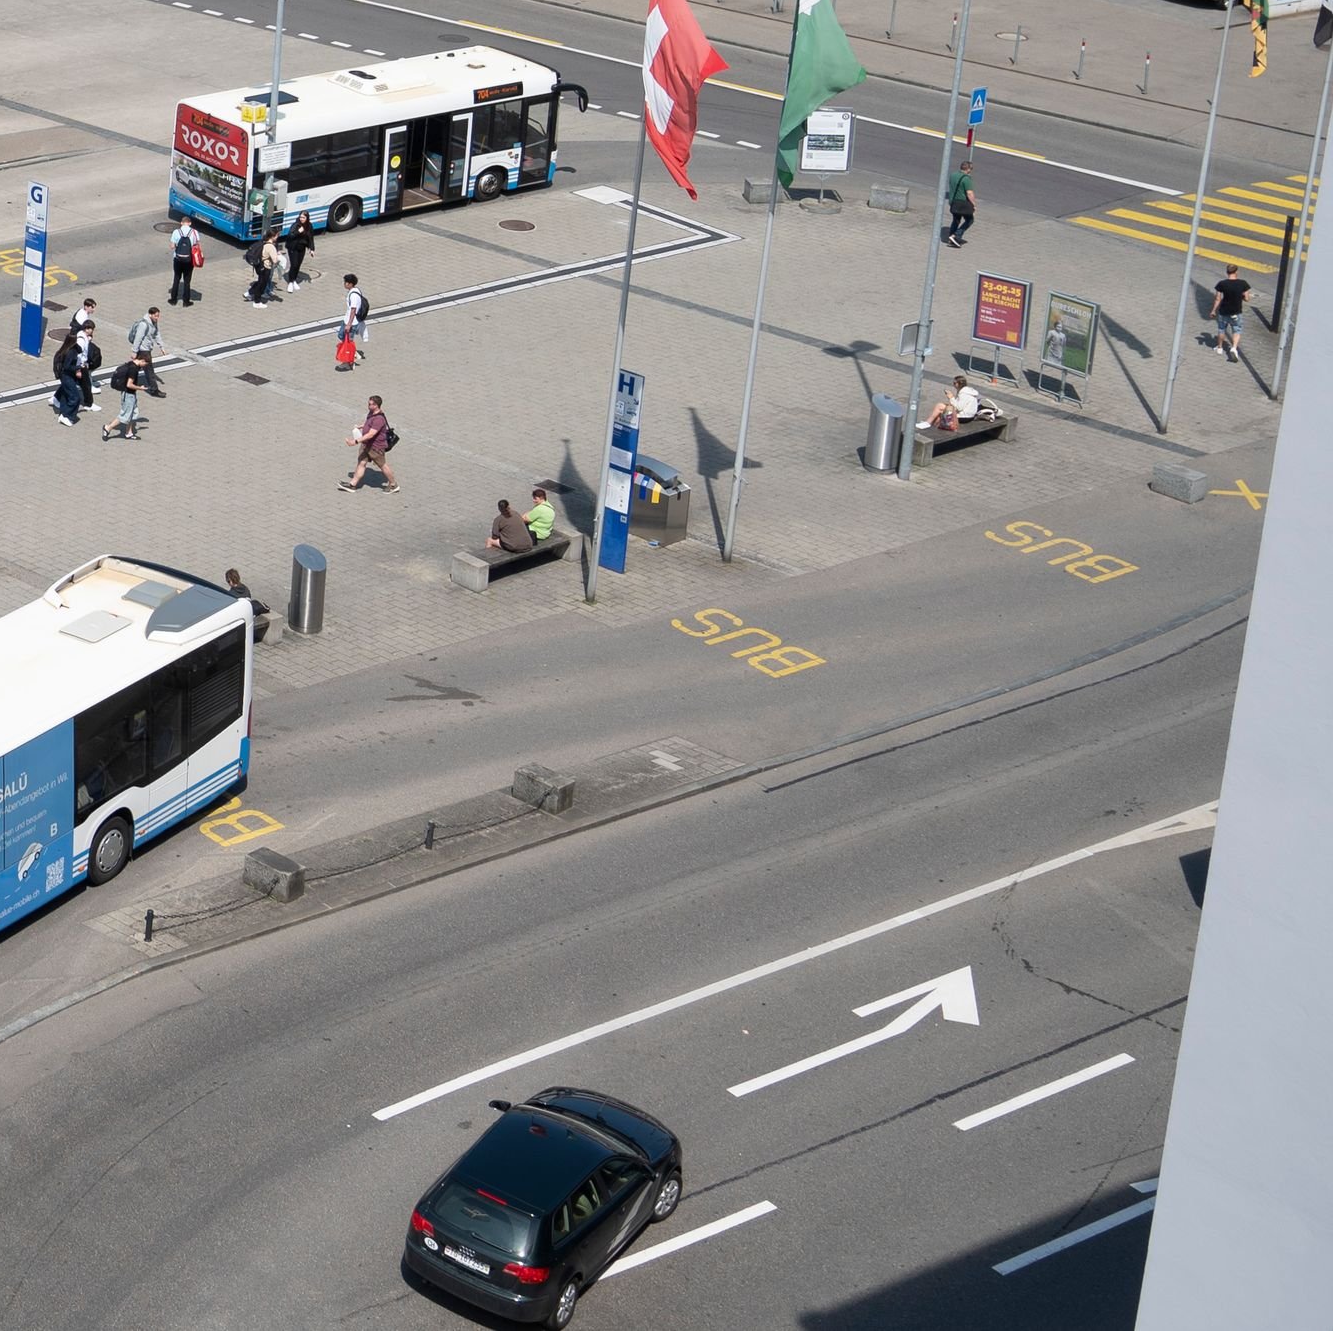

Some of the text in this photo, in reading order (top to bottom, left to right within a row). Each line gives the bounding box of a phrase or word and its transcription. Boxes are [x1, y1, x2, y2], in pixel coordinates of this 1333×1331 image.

[182, 125, 239, 166] ROXOR
[31, 186, 43, 204] G
[982, 281, 1022, 297] 23.05.25
[982, 291, 1021, 304] LANGE NACHT
[994, 298, 1020, 309] KIRCHEN
[618, 373, 635, 396] H
[984, 521, 1140, 583] BUS
[671, 608, 827, 678] BUS
[50, 822, 58, 837] B
